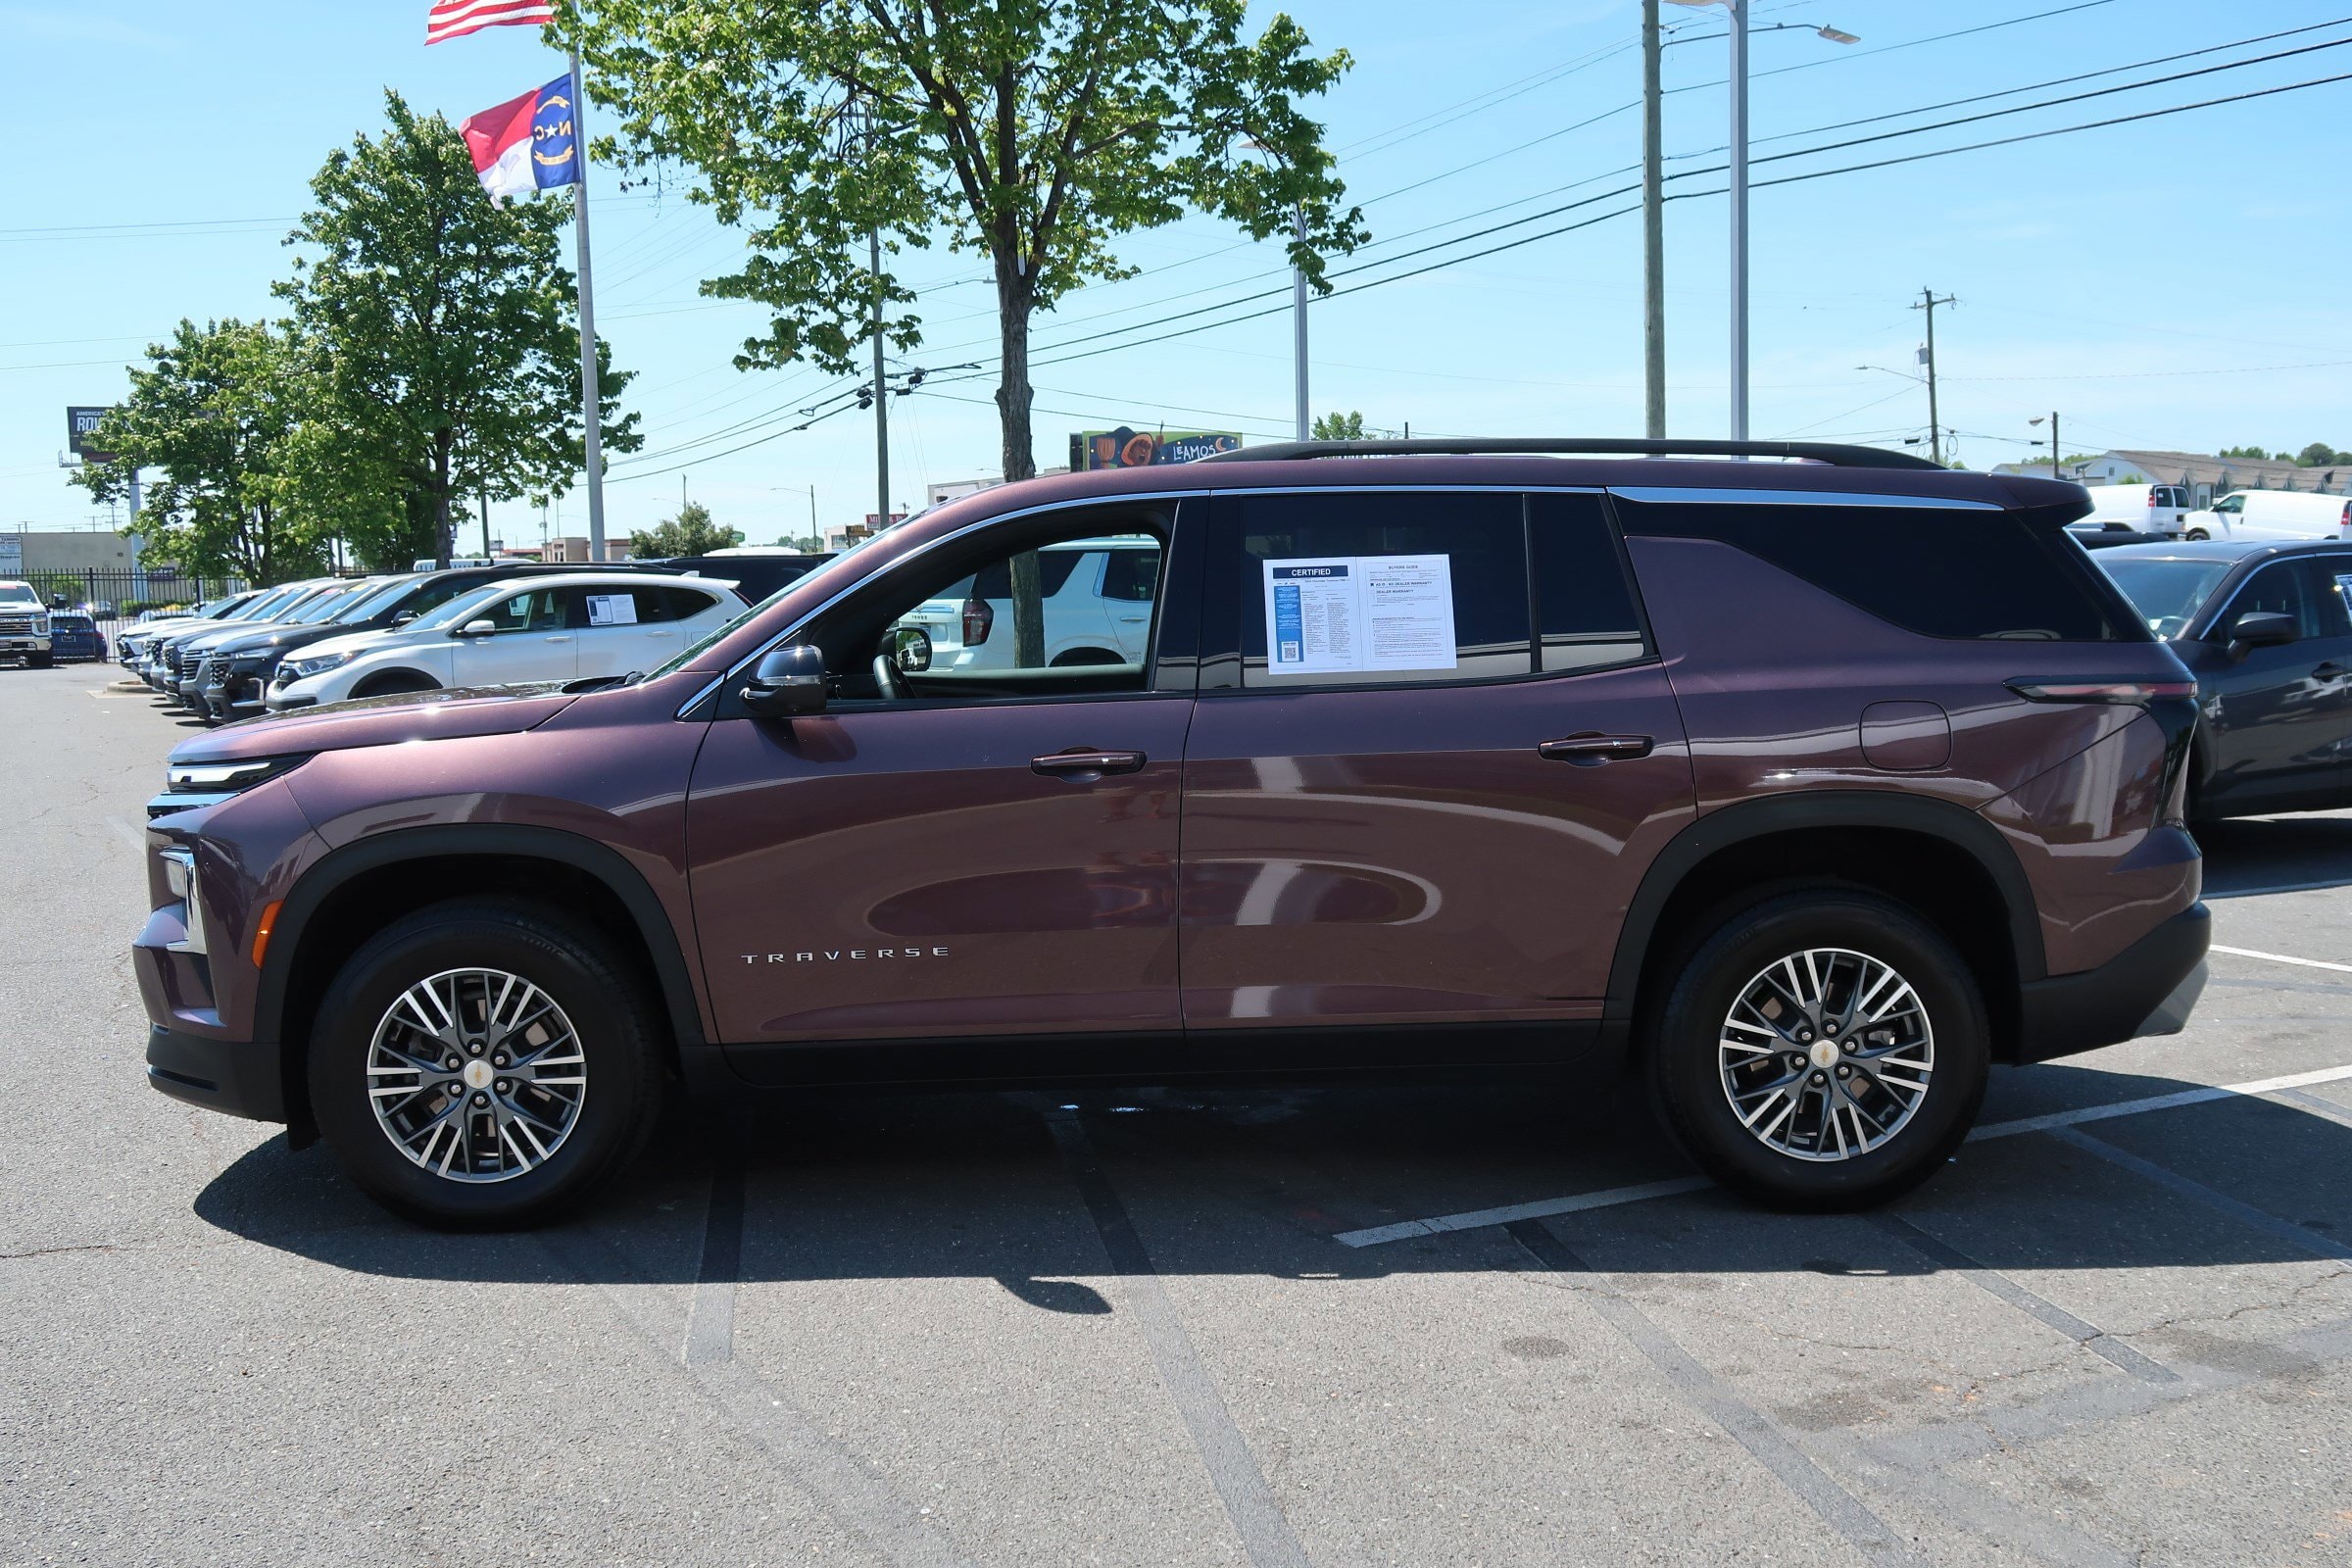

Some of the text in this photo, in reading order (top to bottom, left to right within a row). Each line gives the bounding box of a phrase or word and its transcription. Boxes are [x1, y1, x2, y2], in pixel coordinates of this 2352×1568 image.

[1173, 444, 1216, 462] LEAMOS
[1291, 567, 1332, 577] CERTIFIED
[741, 947, 950, 964] TRAVERSE
